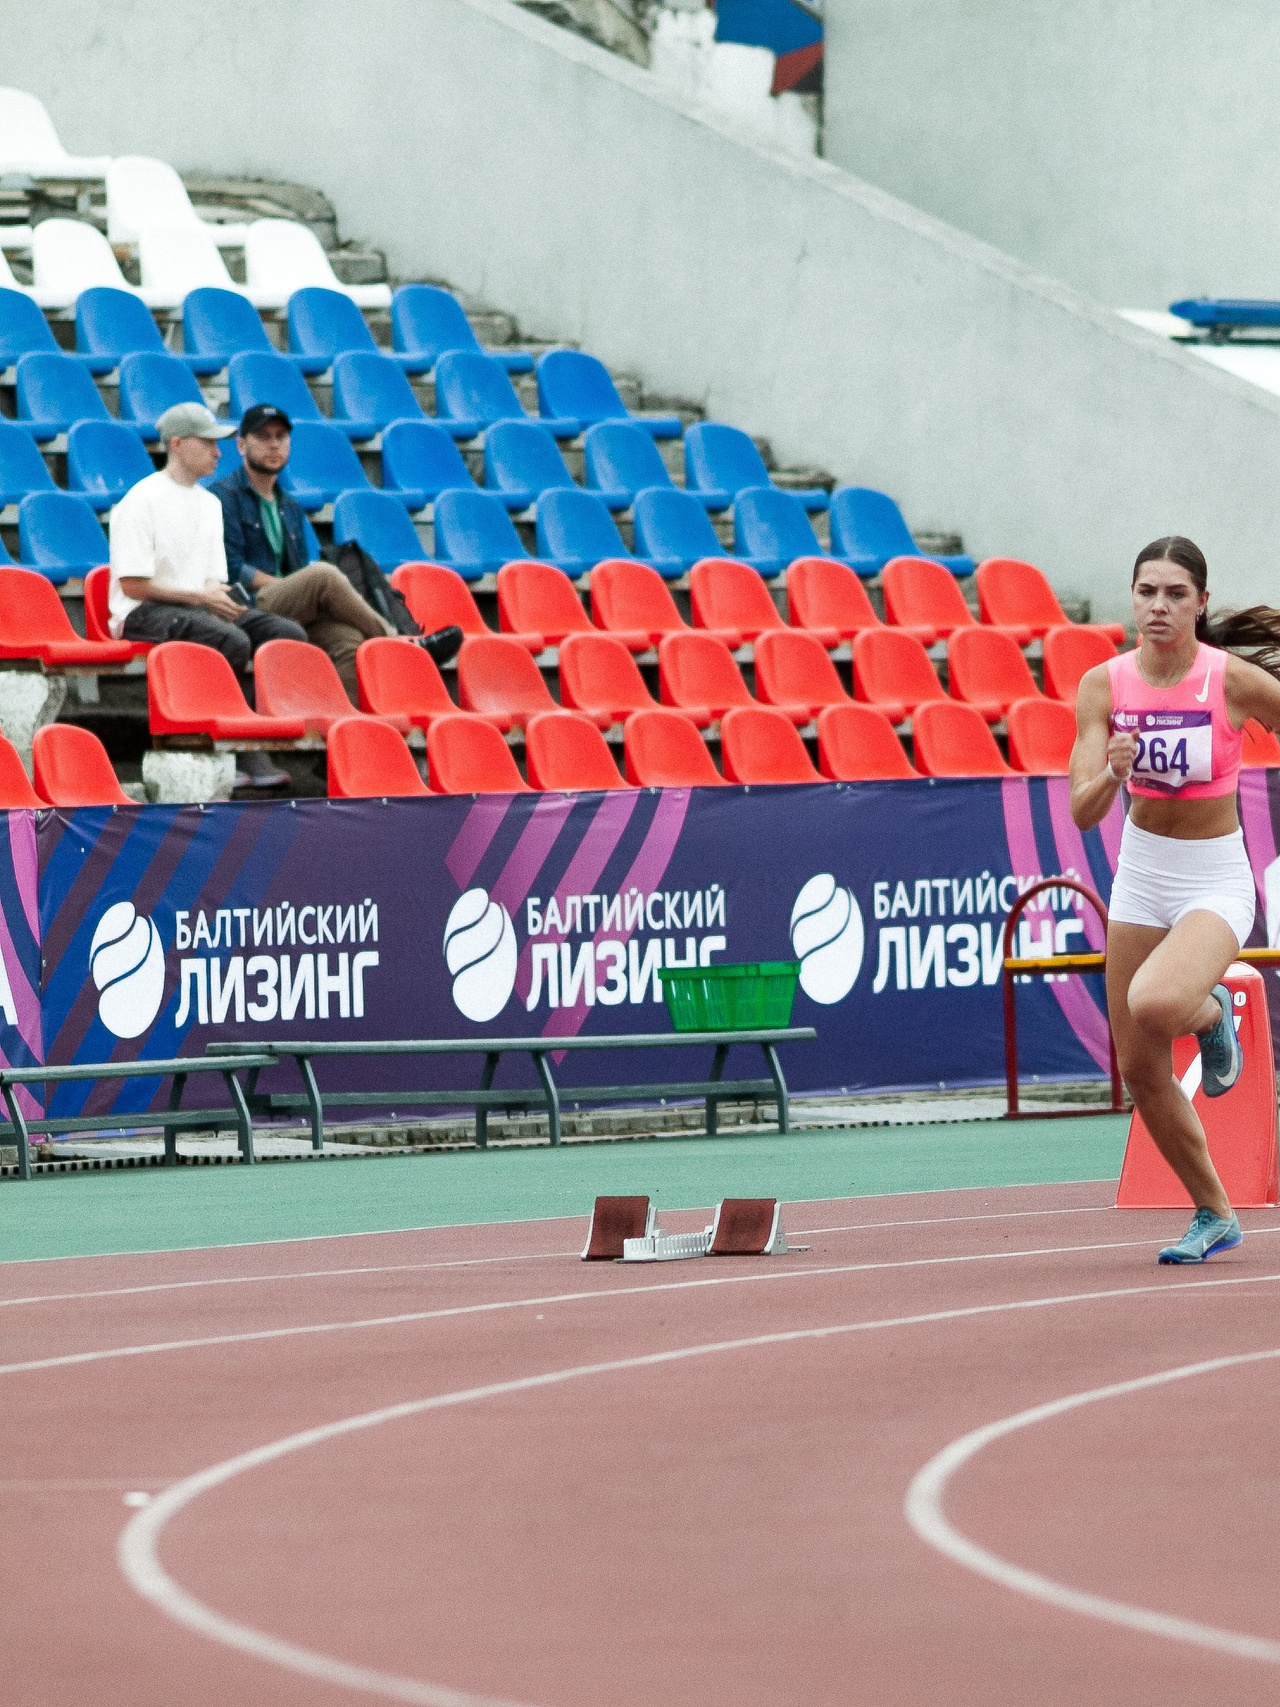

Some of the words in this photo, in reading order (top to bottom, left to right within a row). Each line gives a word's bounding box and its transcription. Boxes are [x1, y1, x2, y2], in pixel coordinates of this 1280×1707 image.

[1132, 737, 1190, 777] 264
[525, 884, 727, 936] БАЛТИЙСКИЙ
[873, 868, 1085, 920] БАЛТИЙСКИЙ
[174, 898, 380, 950] БАЛТИЙСКИЙ
[873, 919, 1084, 995] ЛИЗИНГ
[174, 951, 380, 1028] ЛИЗИНГ
